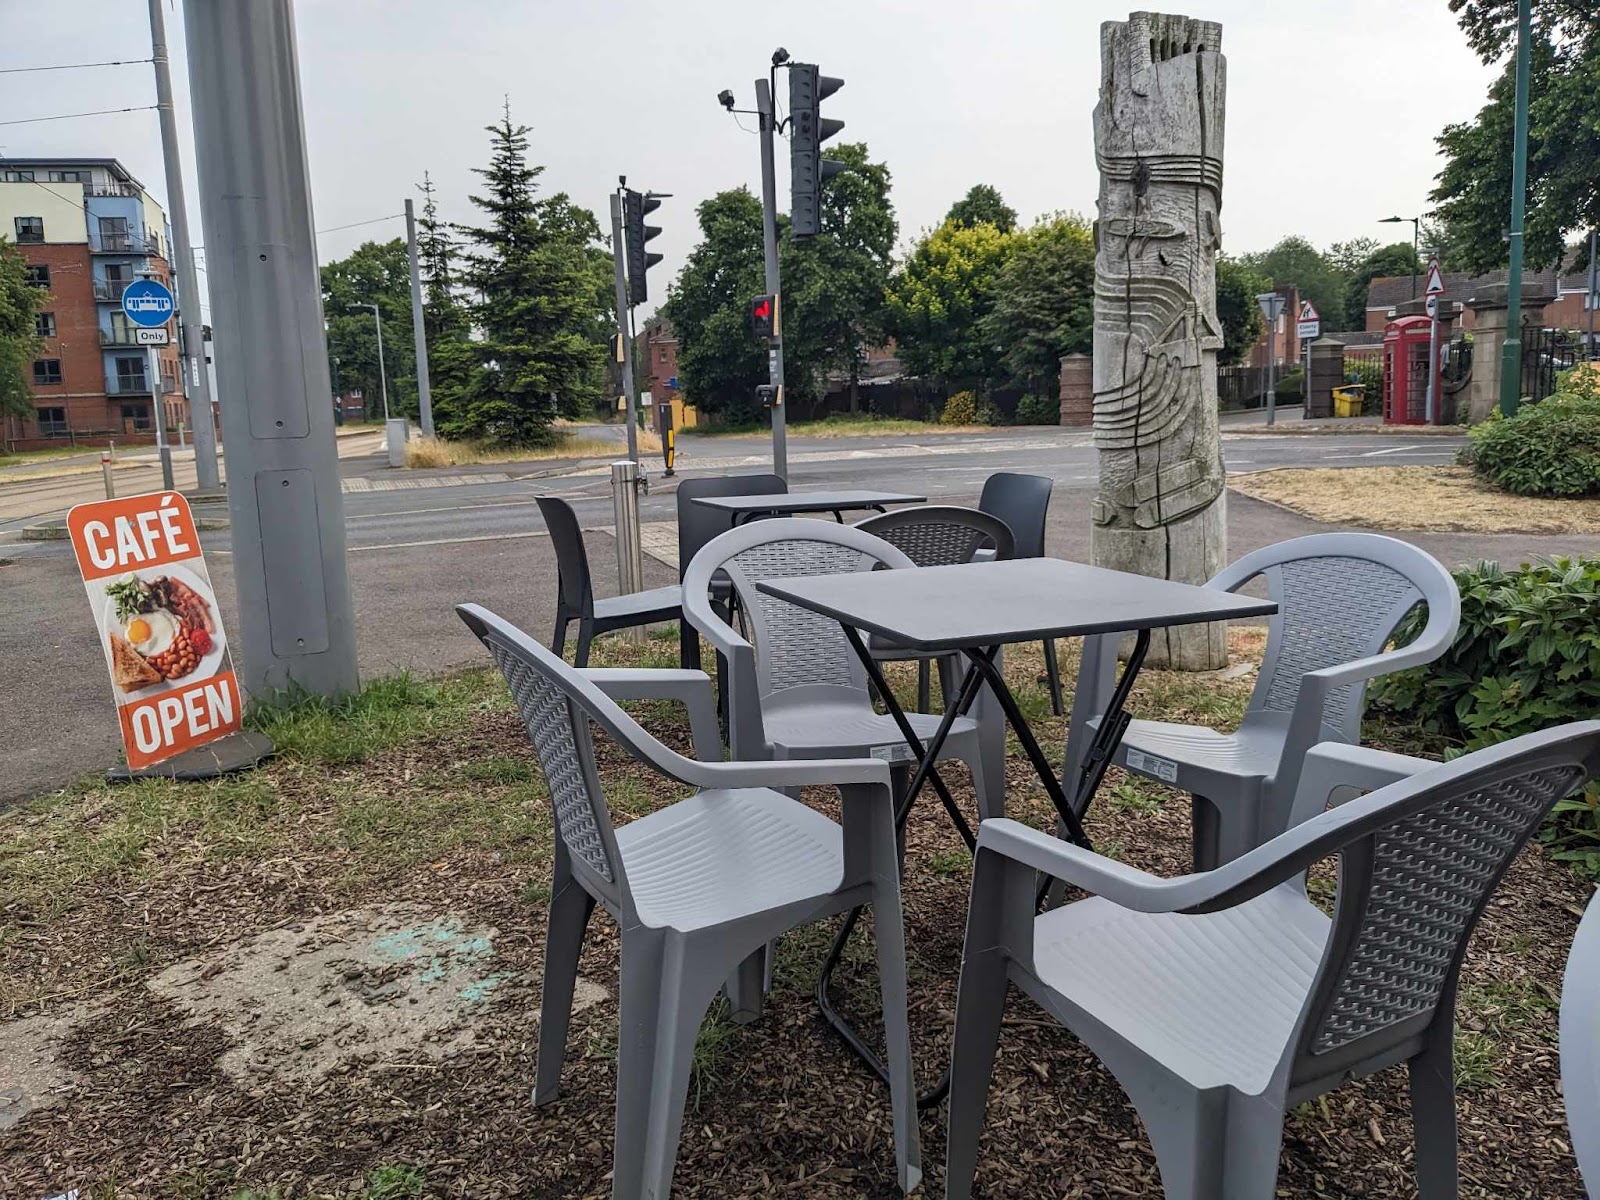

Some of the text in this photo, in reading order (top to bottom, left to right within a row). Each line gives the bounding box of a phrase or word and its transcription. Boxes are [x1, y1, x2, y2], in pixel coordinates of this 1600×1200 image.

[141, 332, 164, 342] Only
[83, 495, 190, 570] CAFÉ
[132, 679, 234, 754] OPEN
